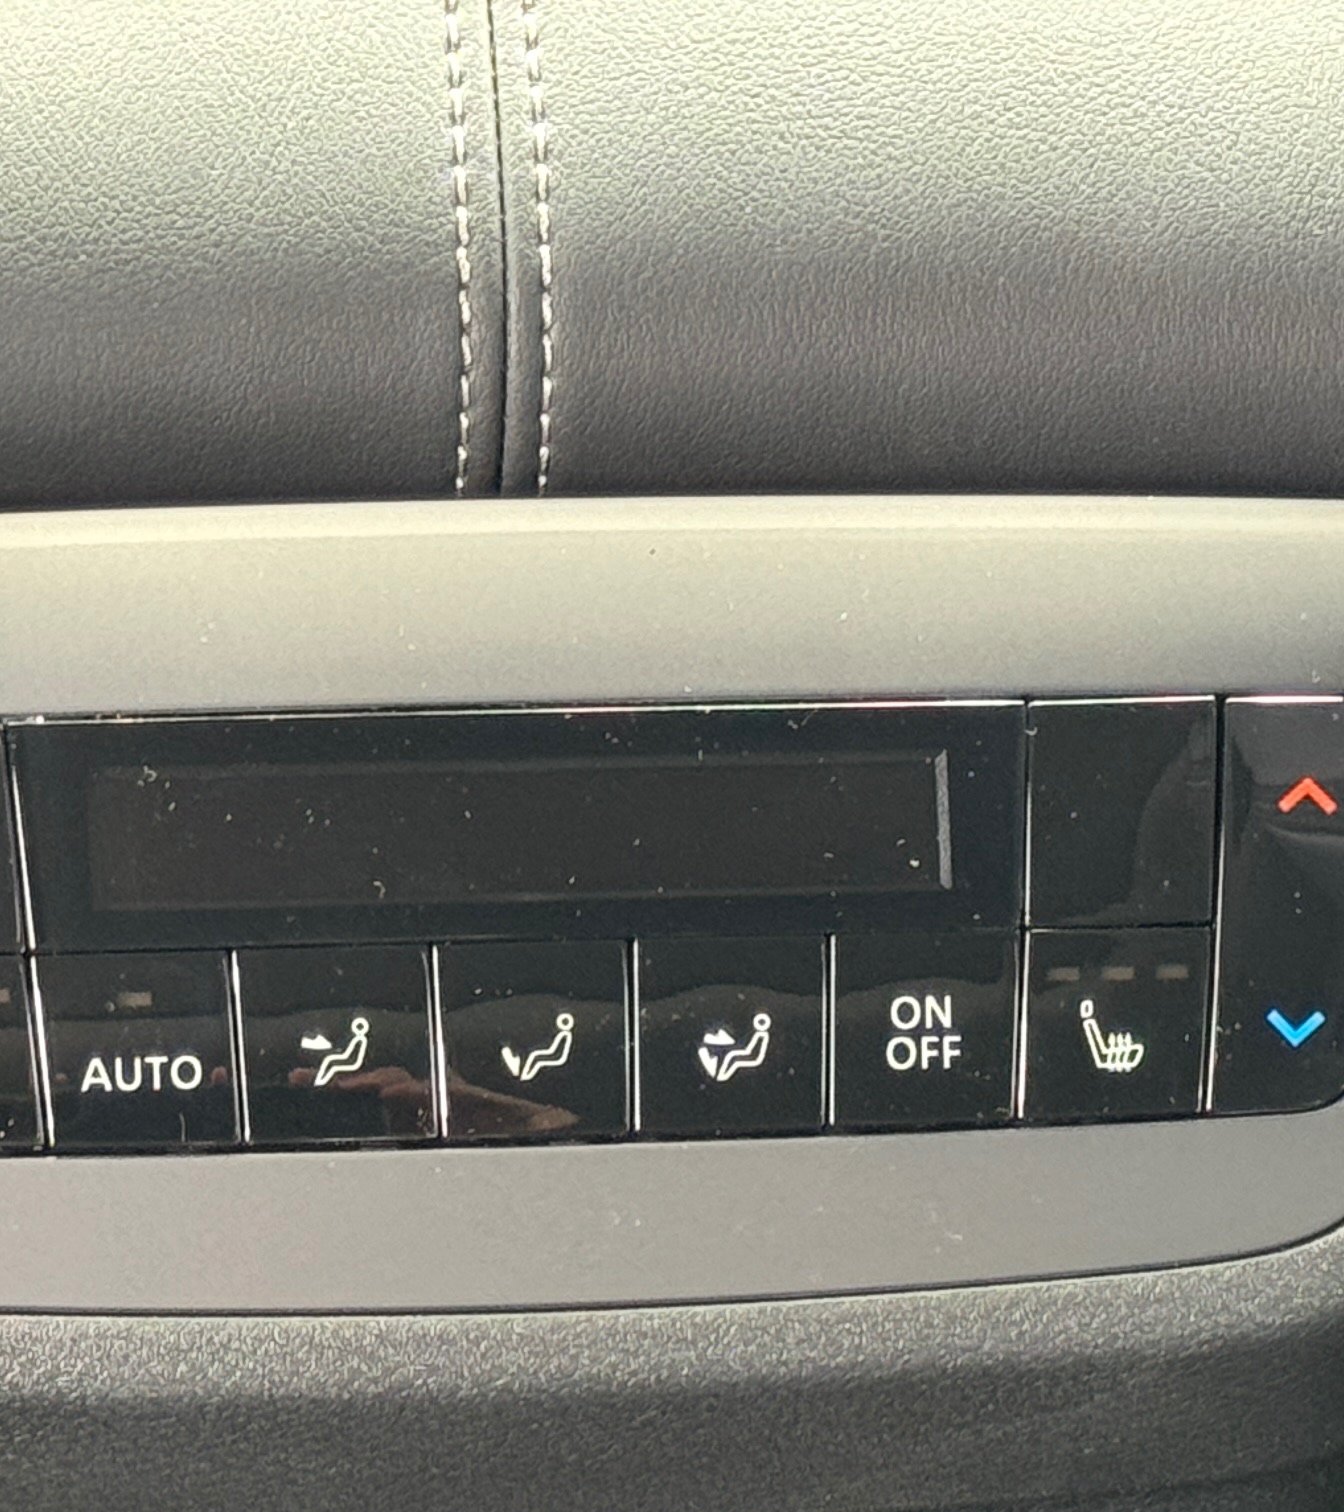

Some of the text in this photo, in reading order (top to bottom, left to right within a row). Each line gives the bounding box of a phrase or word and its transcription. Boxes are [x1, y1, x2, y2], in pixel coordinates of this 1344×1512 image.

[889, 994, 953, 1031] ON
[885, 1034, 962, 1071] OFF
[80, 1054, 203, 1093] AUTO
